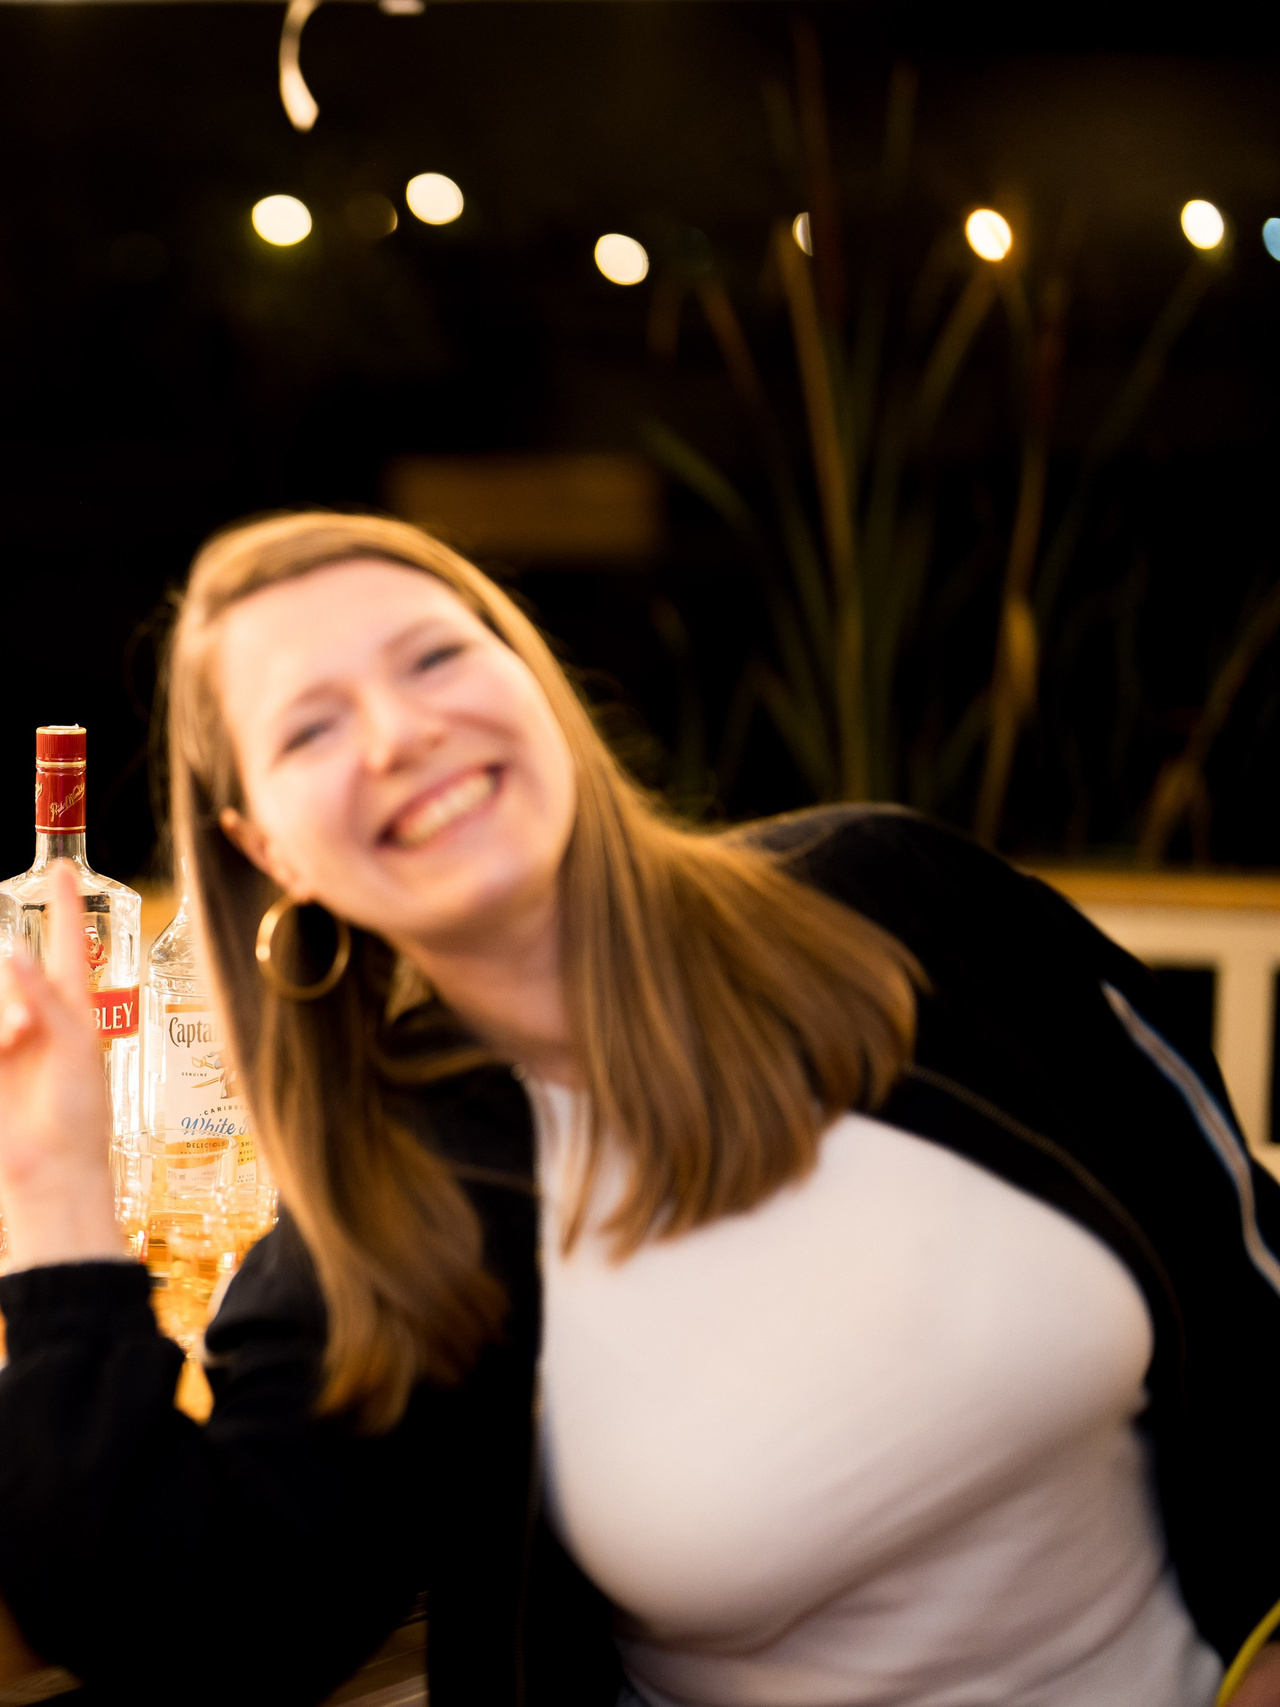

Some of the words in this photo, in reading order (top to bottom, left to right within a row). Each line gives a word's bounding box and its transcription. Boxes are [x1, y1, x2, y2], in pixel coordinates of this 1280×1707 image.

[90, 1001, 133, 1031] BLEY
[169, 1017, 215, 1048] Capta
[181, 1117, 236, 1135] White
